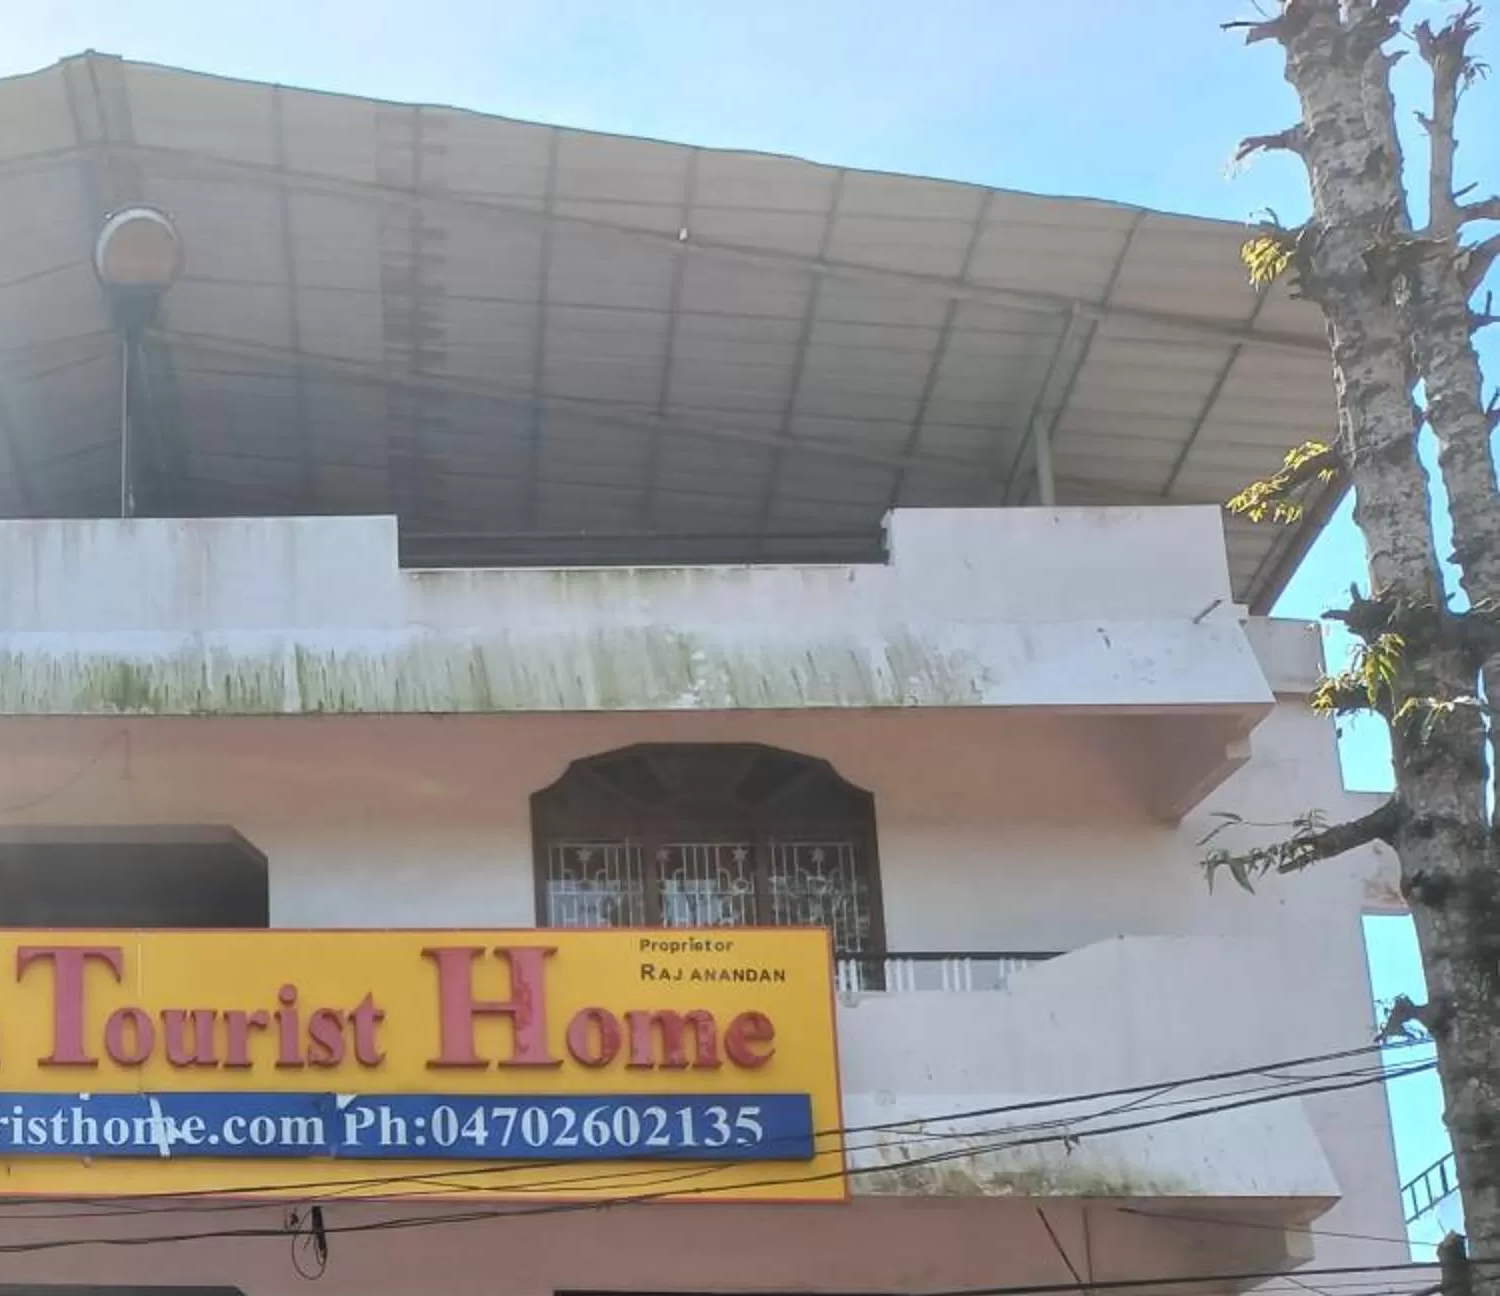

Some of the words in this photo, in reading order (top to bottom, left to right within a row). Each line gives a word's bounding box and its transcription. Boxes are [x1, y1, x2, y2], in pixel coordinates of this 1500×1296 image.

[639, 936, 734, 954] Proprietor
[640, 963, 683, 982] RAJ
[690, 968, 786, 983] ANANDAN
[14, 946, 387, 1069] Tourist
[421, 946, 777, 1070] Home
[342, 1104, 764, 1148] Ph:04702602135
